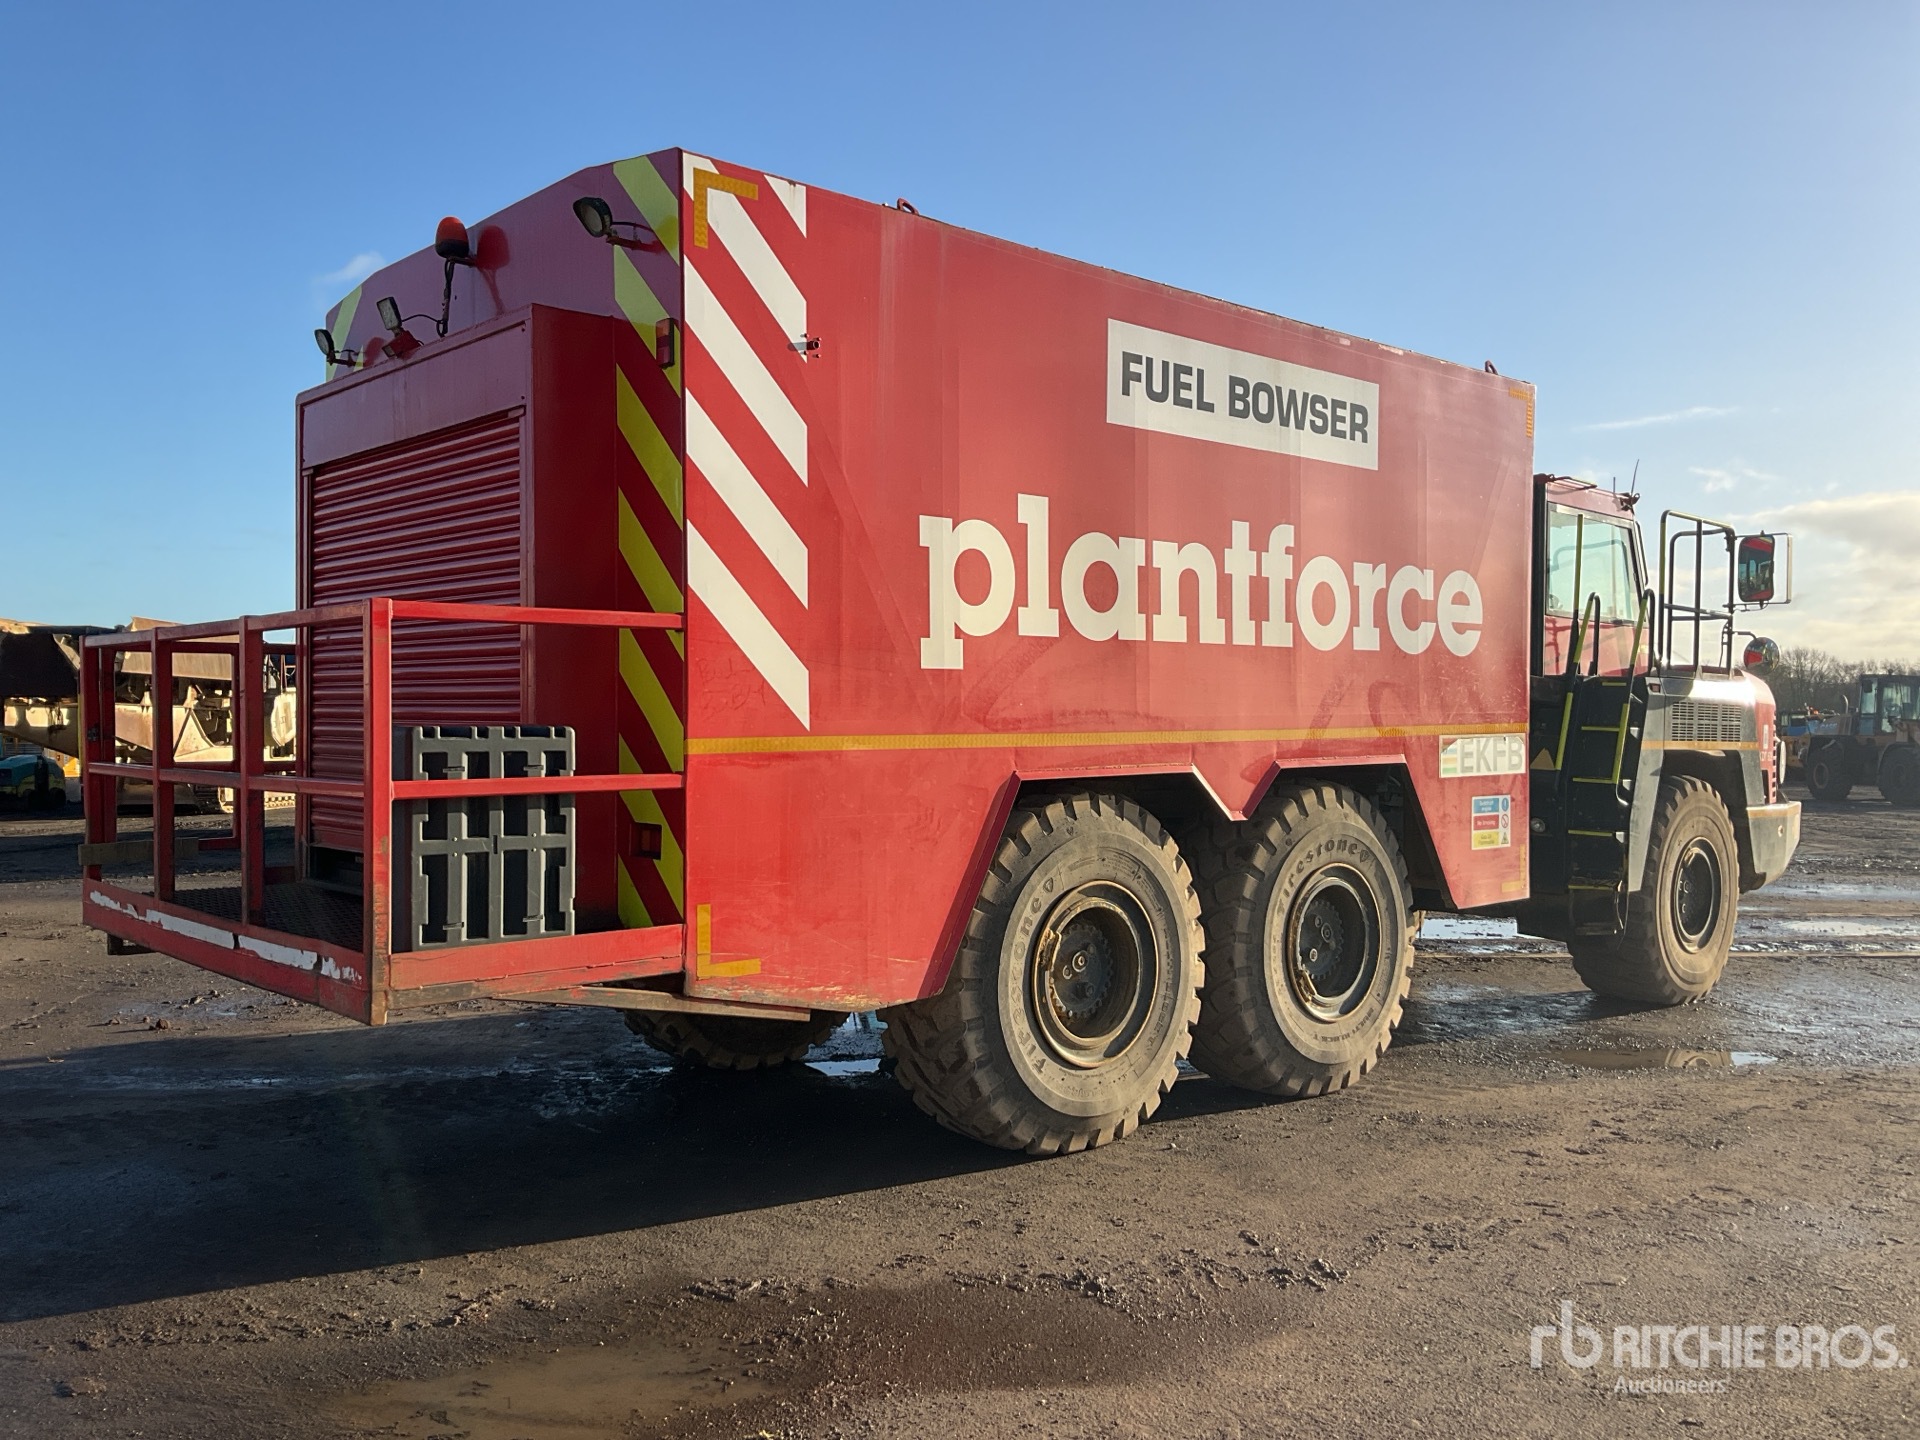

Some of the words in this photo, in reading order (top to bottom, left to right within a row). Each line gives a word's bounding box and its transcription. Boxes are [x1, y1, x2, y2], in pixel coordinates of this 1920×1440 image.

[1121, 351, 1215, 413] FUEL
[1228, 375, 1369, 444] BOWSER
[919, 493, 1484, 670] plantforce
[1459, 736, 1523, 774] EKFB
[1276, 838, 1358, 915] Firestone
[1011, 897, 1047, 1075] Firestone
